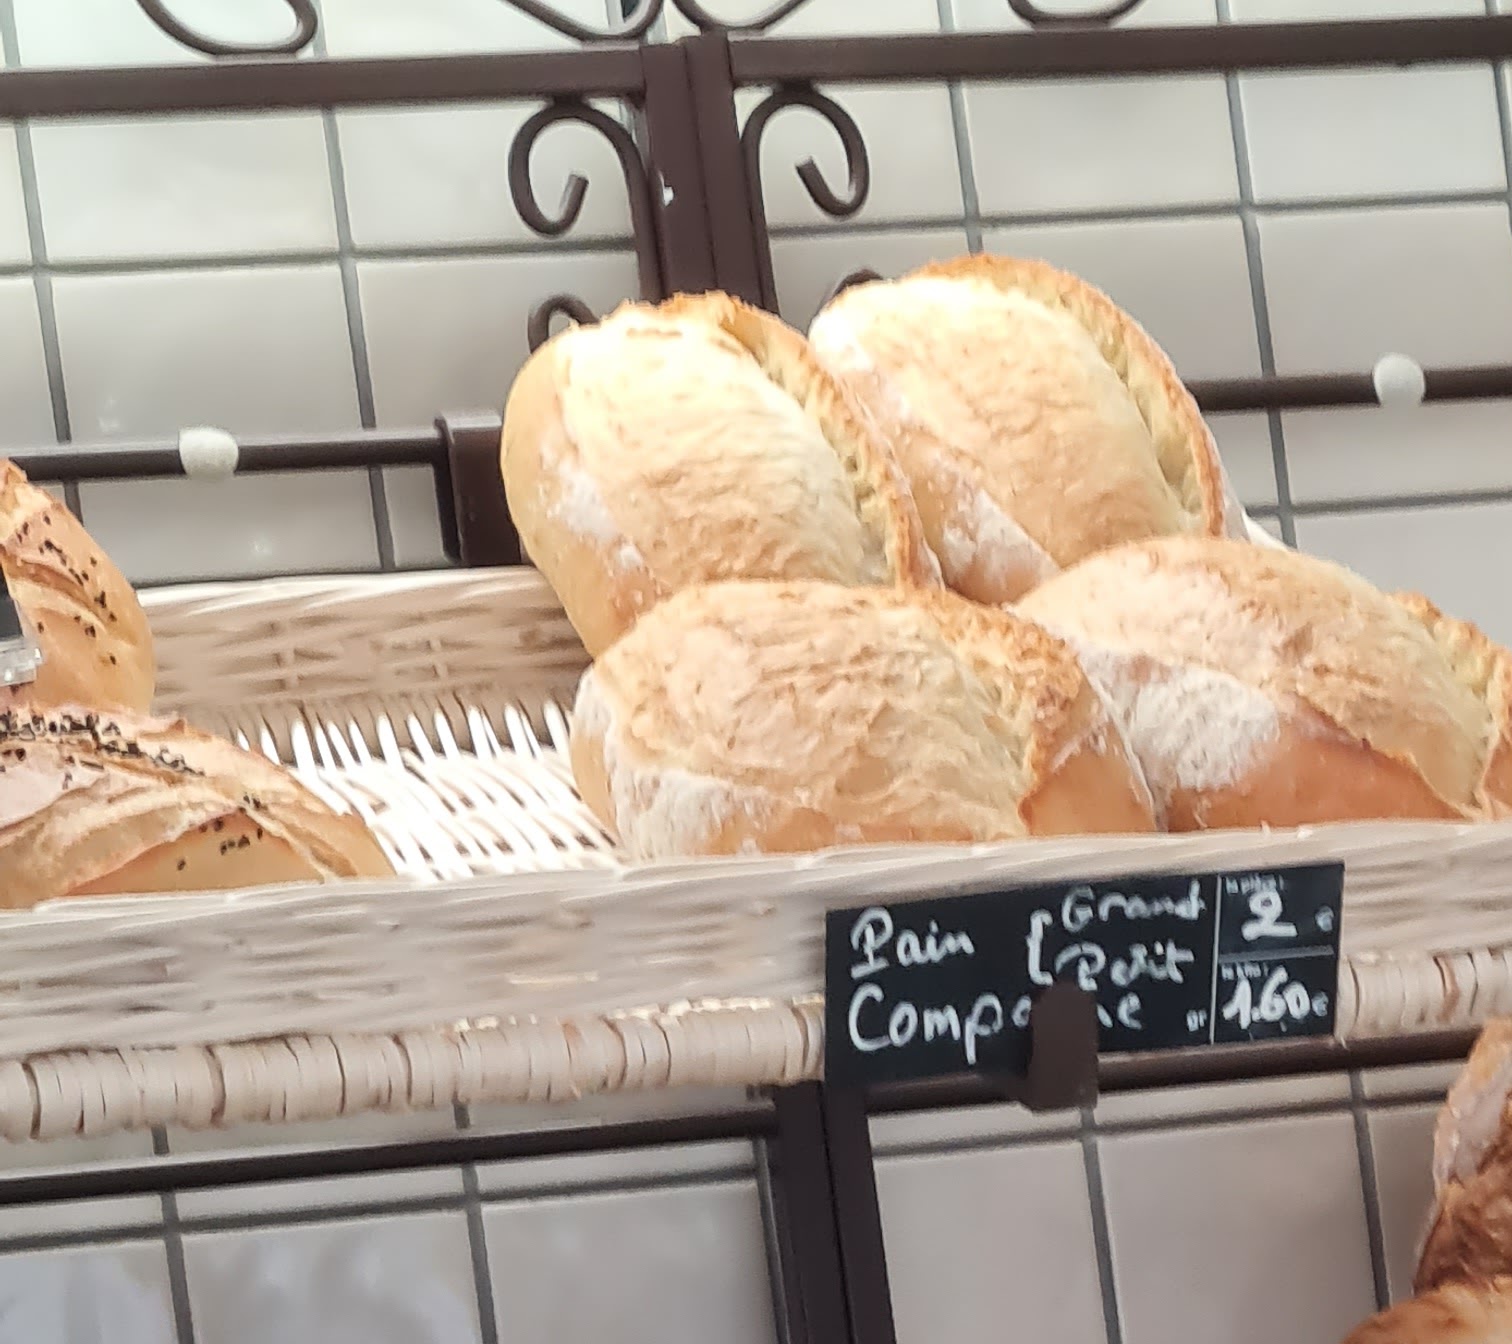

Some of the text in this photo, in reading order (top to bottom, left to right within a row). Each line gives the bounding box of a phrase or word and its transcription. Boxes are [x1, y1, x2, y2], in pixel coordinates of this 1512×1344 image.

[1061, 879, 1206, 933] Grand
[1241, 889, 1298, 942] 2
[850, 906, 975, 979] Pain
[1055, 938, 1195, 991] Petit
